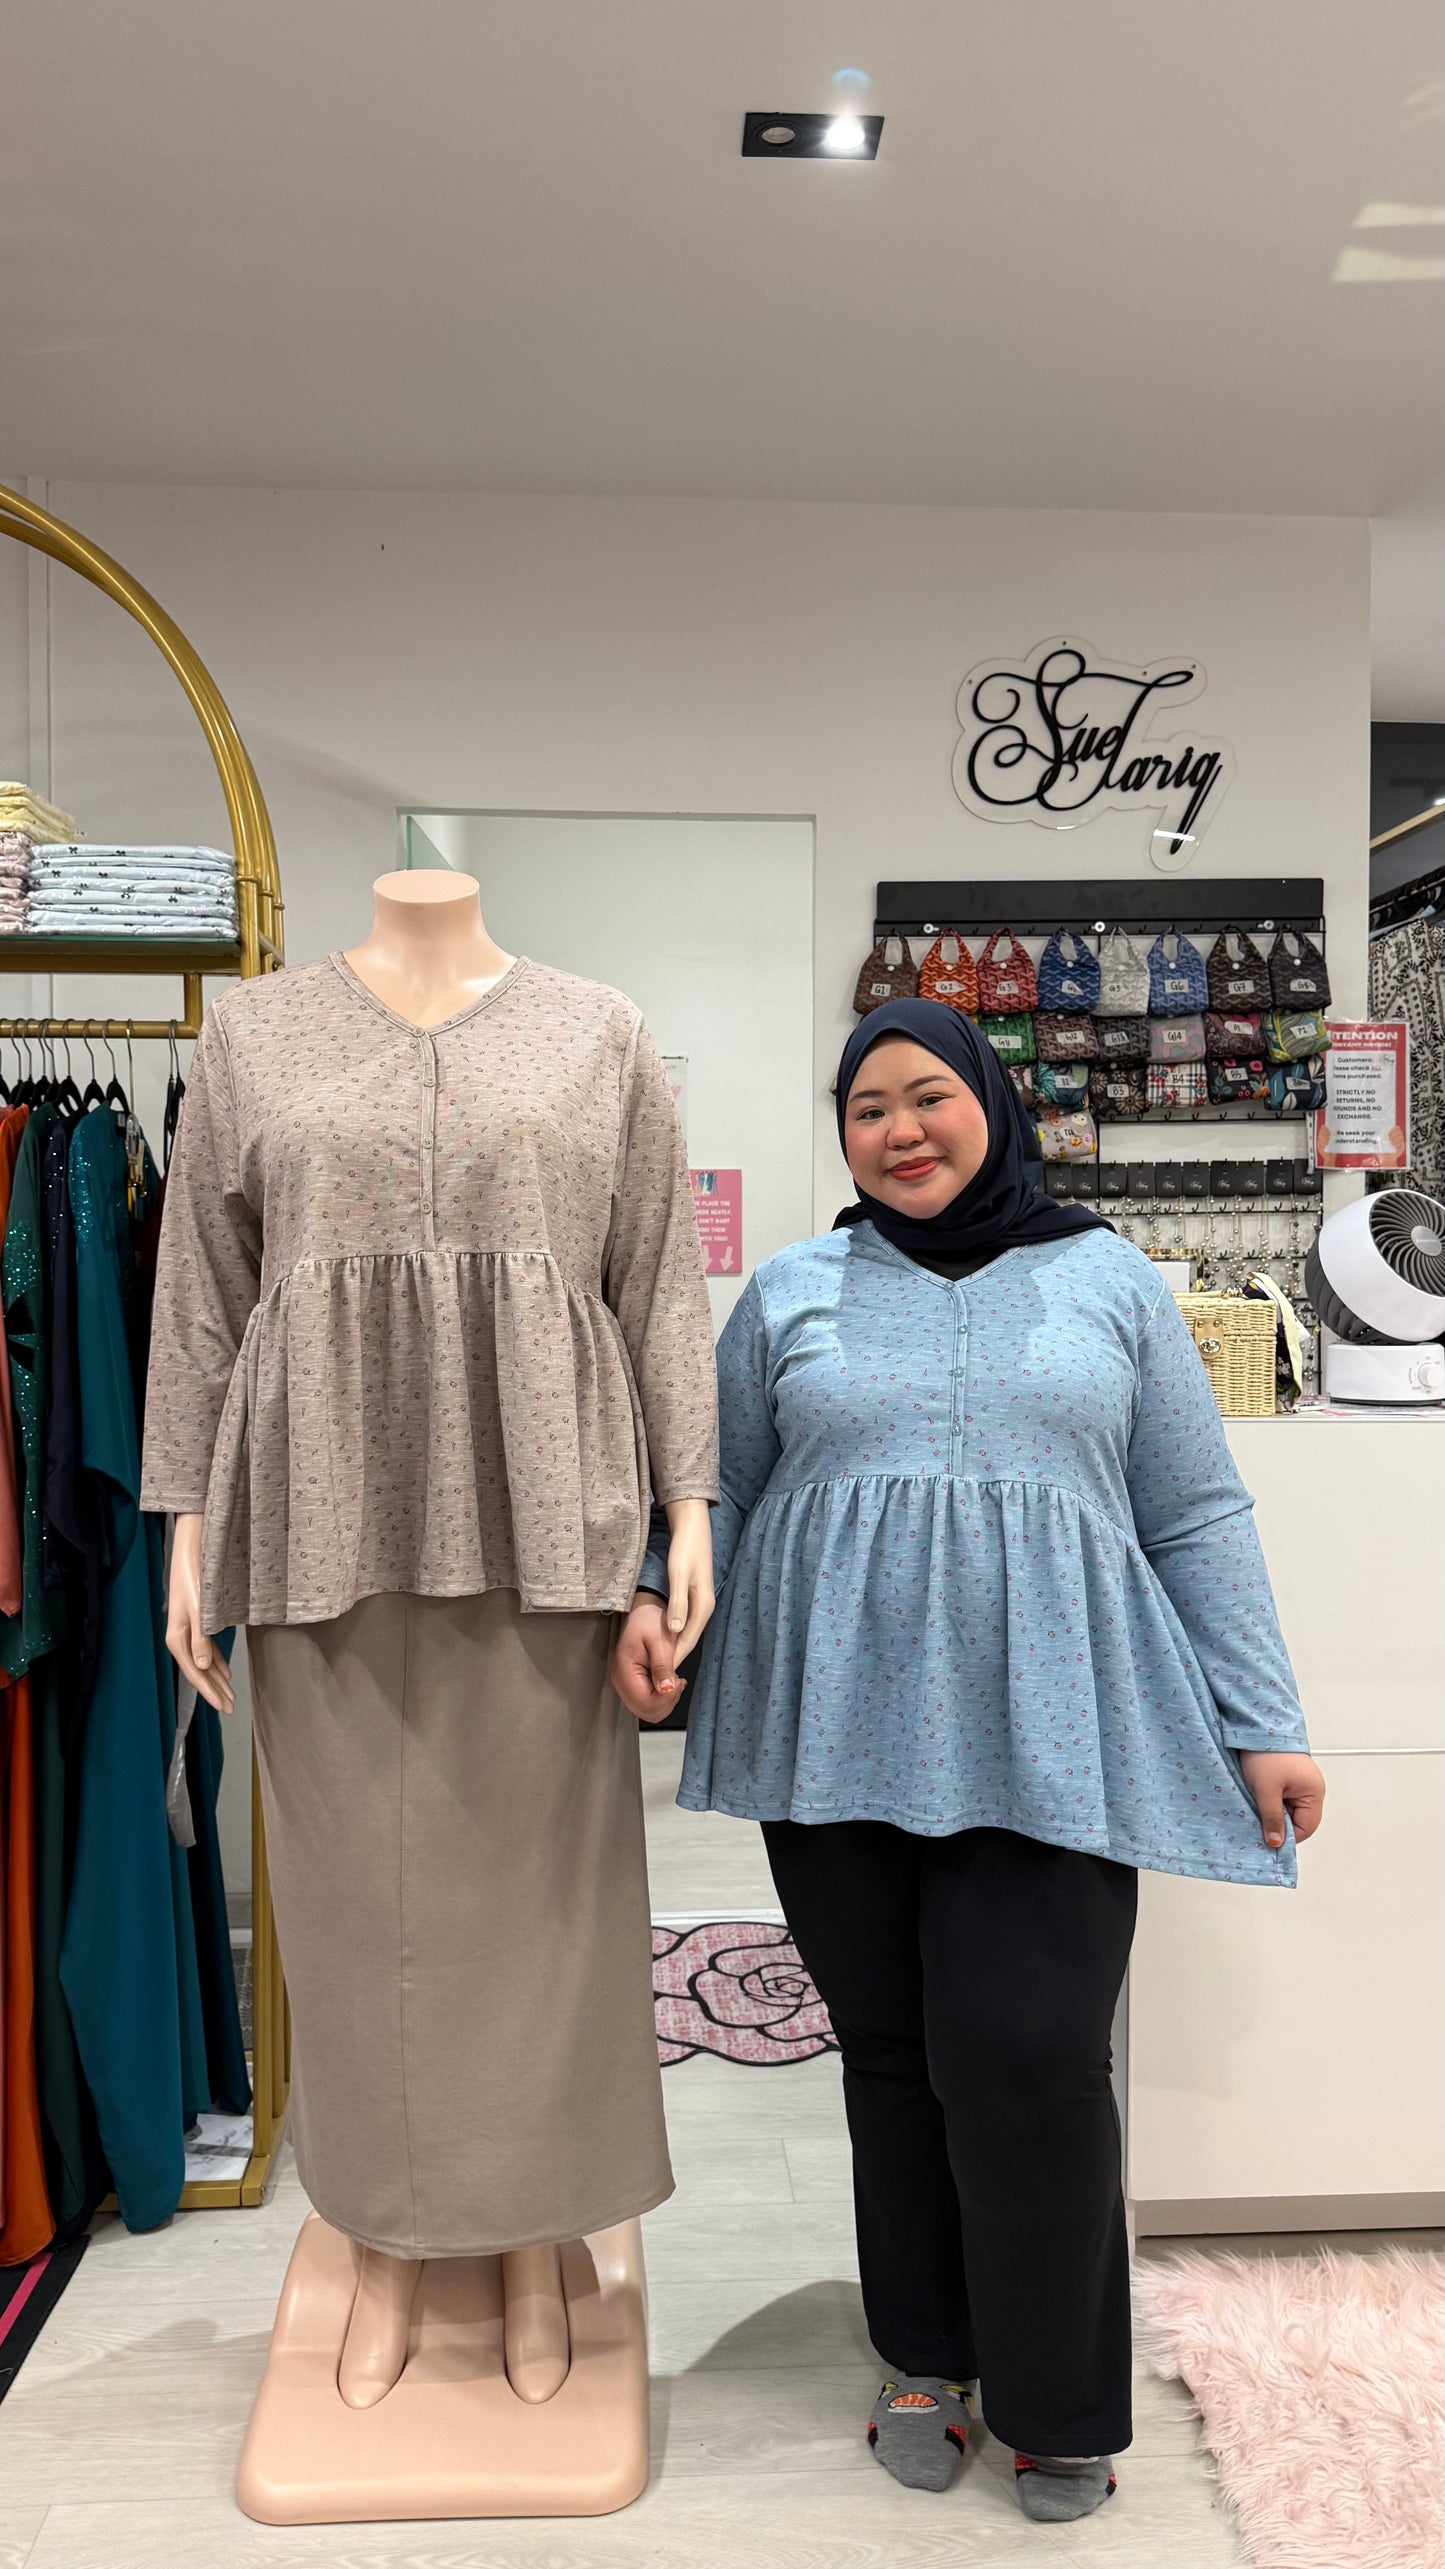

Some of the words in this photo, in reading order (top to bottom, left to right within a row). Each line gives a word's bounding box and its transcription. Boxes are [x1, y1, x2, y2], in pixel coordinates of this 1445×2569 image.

[874, 984, 886, 995] G1
[940, 981, 953, 991] G2
[1170, 981, 1184, 991] G6
[1233, 983, 1246, 992] G7
[1329, 1031, 1398, 1040] TENTION
[1172, 1074, 1184, 1084] B4
[1230, 1070, 1242, 1079] B5
[1112, 1086, 1125, 1096] B3
